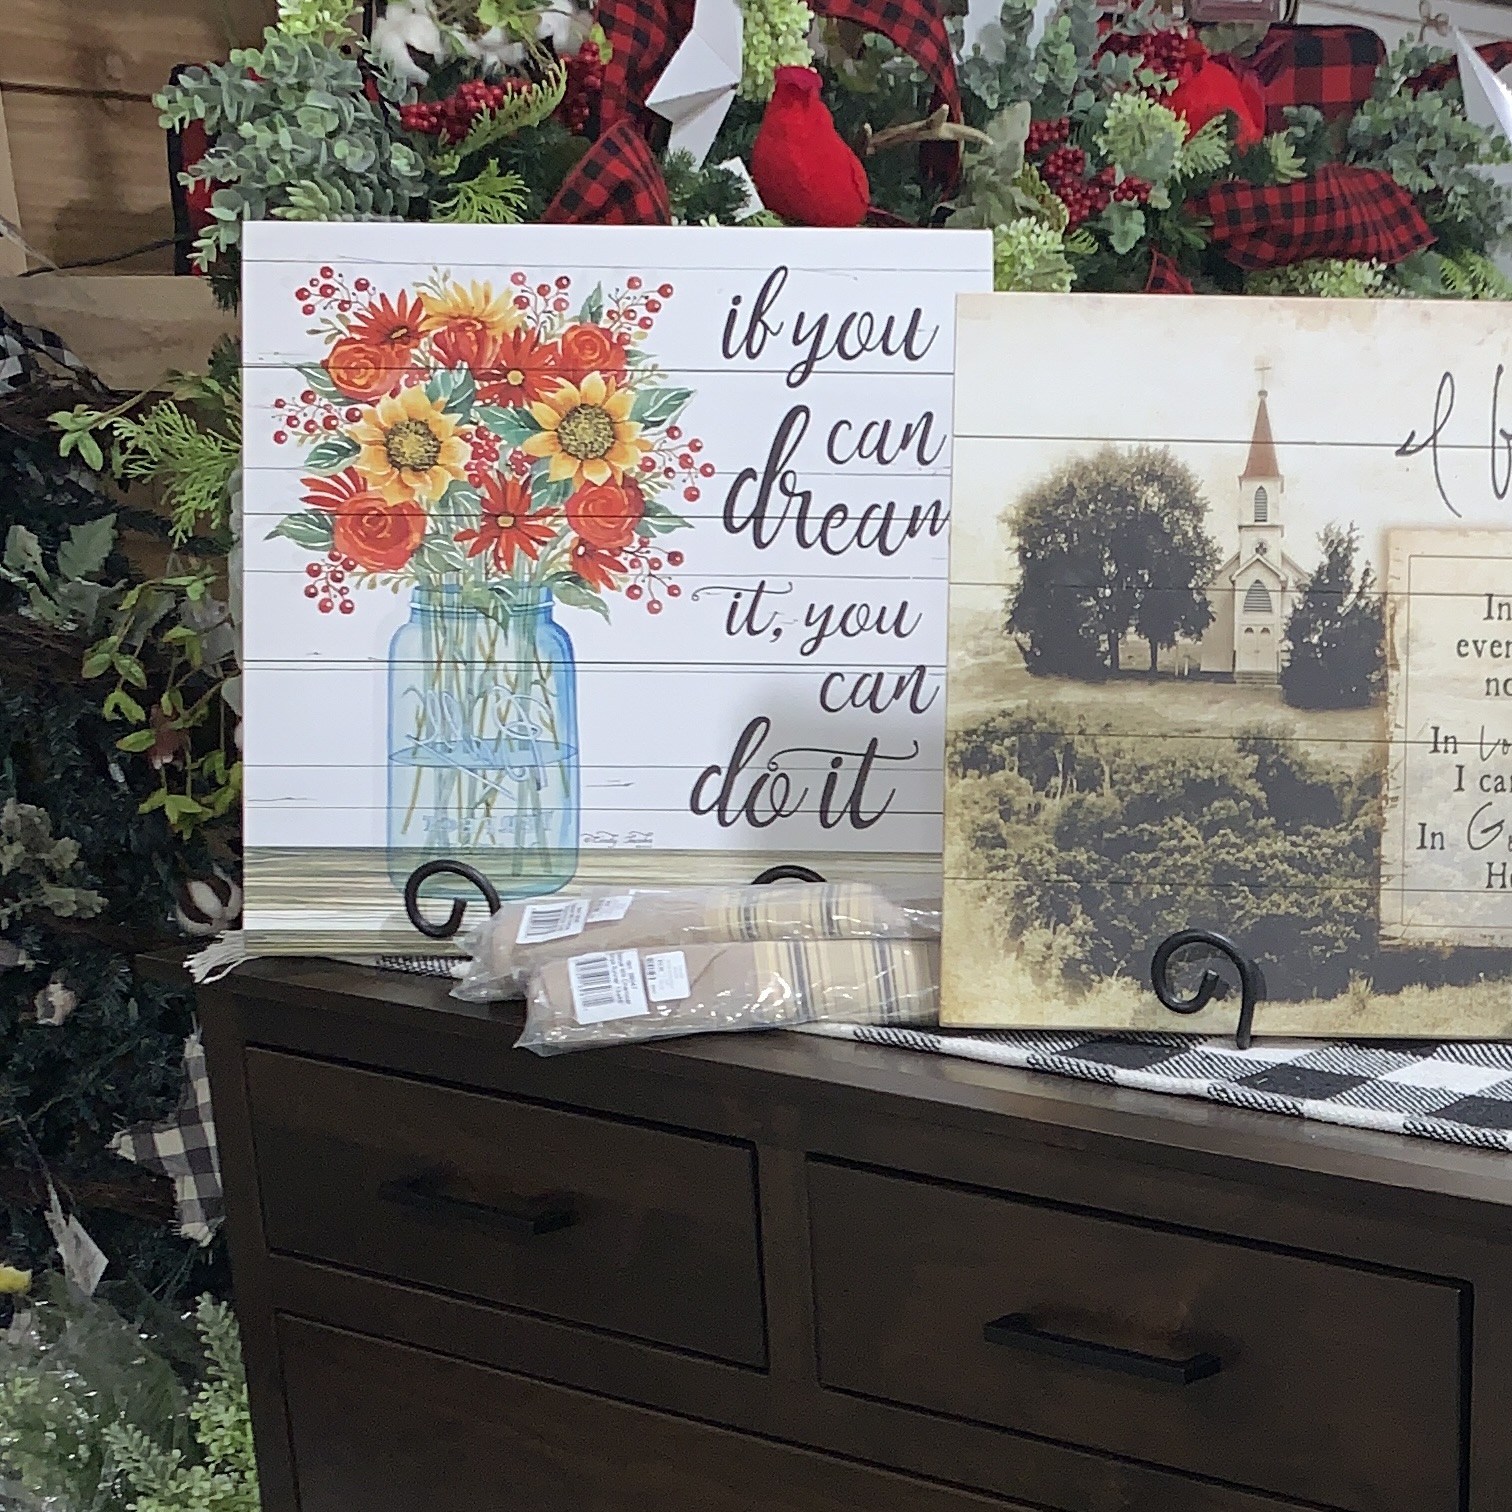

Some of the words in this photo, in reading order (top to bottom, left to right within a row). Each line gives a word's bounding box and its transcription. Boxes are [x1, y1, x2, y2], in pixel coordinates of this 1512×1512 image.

[722, 265, 788, 360] if
[786, 307, 940, 388] you
[827, 411, 947, 465] can
[691, 580, 793, 642] it,
[800, 601, 922, 656] you
[1483, 593, 1512, 621] In
[820, 665, 939, 714] can
[1429, 726, 1458, 754] In
[690, 716, 808, 828] do
[768, 738, 918, 829] it
[1452, 764, 1466, 793] I
[1416, 822, 1446, 851] In
